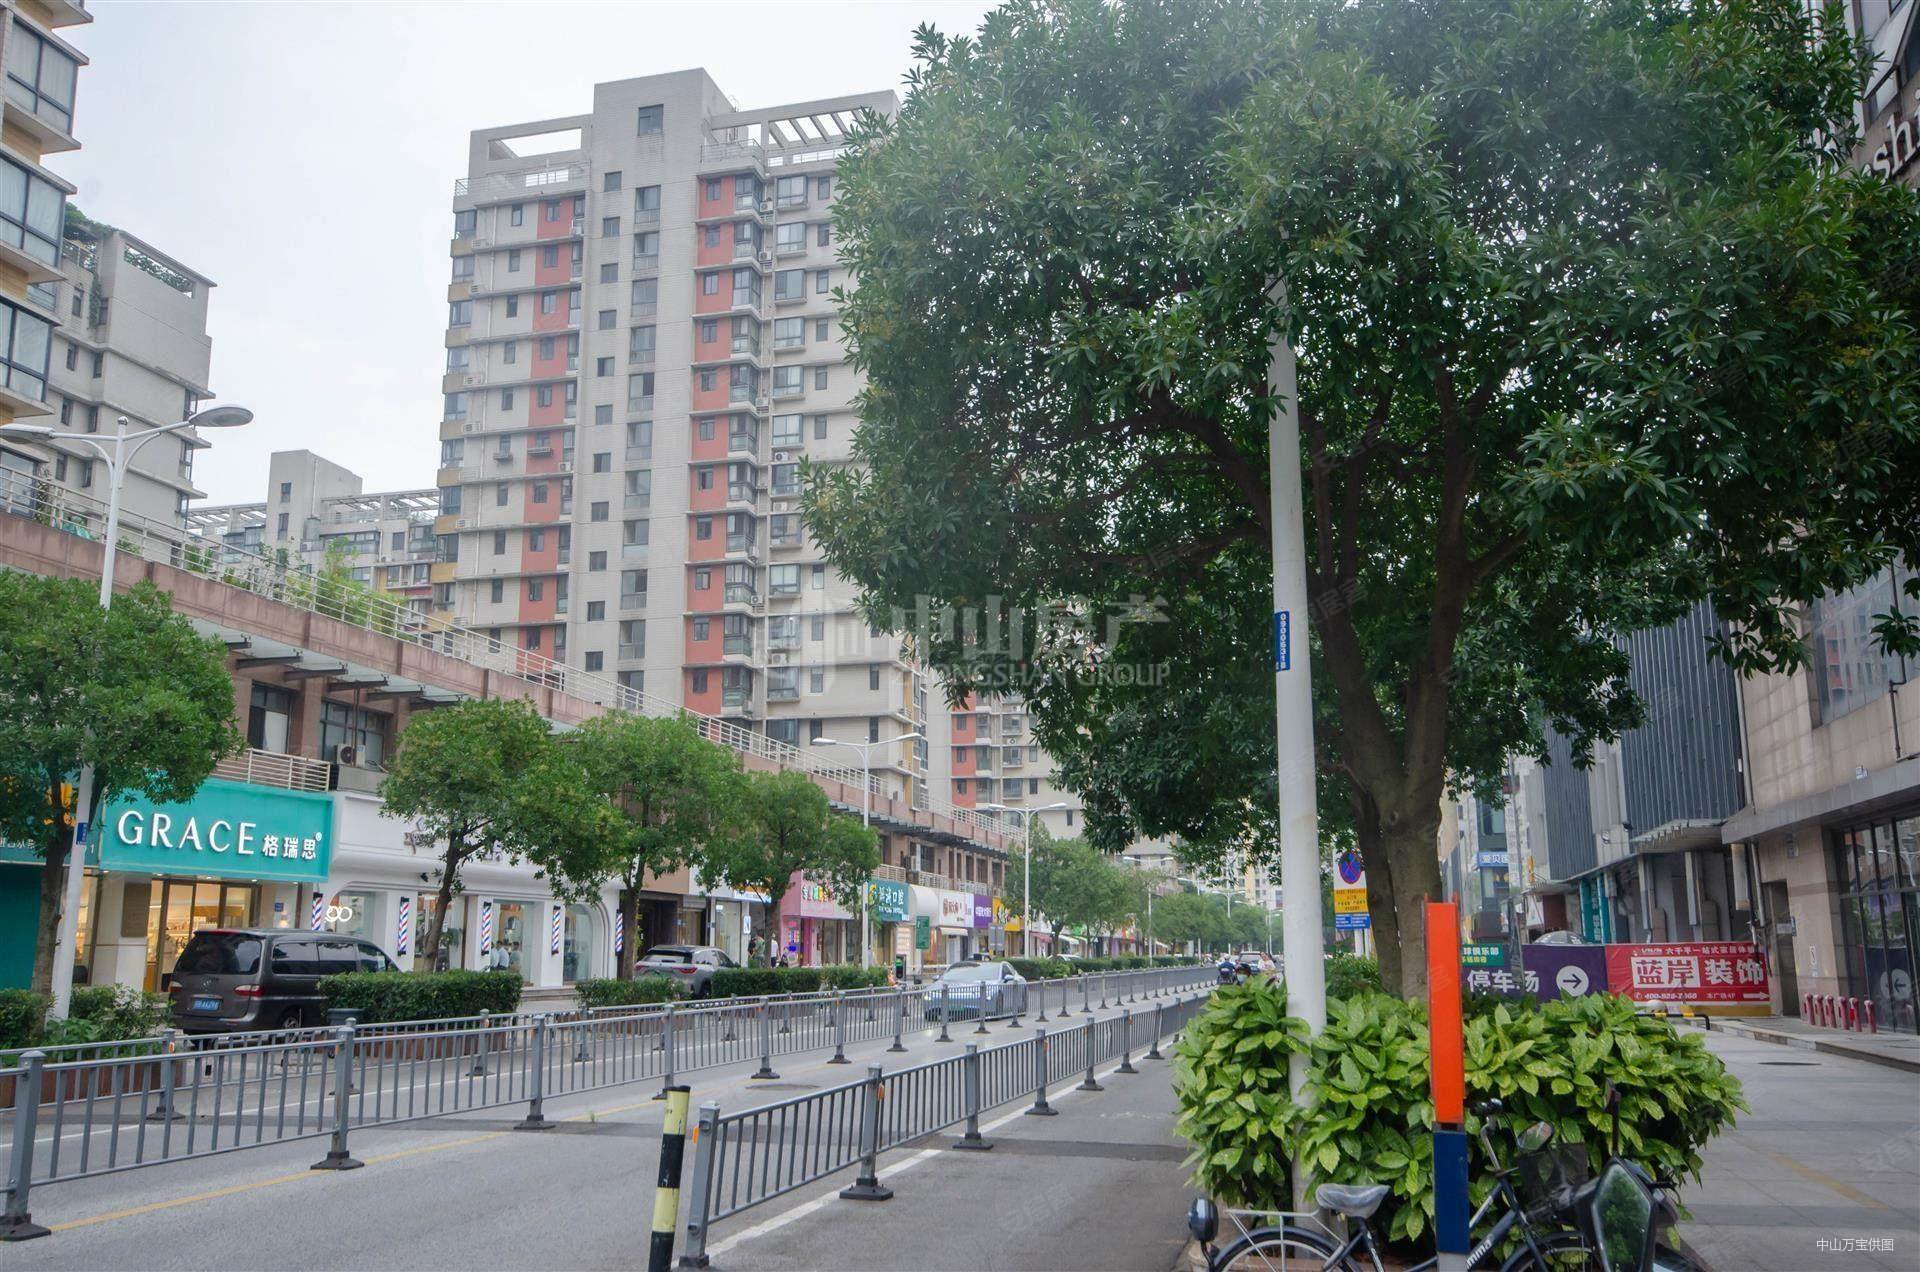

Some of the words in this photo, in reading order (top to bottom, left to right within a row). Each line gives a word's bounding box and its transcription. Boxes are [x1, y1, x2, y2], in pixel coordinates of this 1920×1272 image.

[117, 810, 257, 855] GRACE
[262, 834, 317, 860] 格瑞思
[1467, 969, 1540, 993] 停车场
[1635, 958, 1764, 985] 蓝岸装饰
